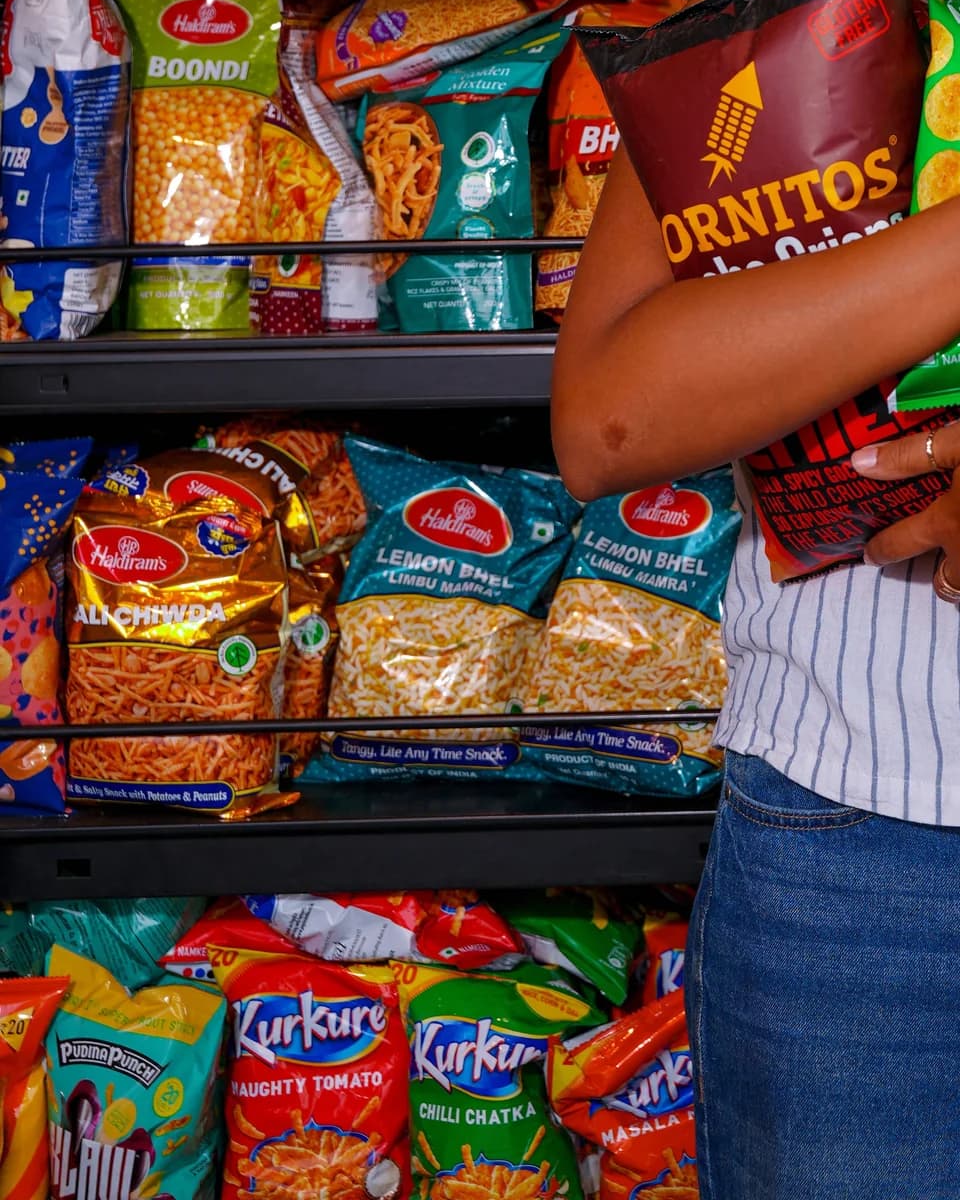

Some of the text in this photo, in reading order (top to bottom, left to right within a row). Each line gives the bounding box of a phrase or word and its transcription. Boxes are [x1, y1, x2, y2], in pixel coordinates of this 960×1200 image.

[173, 11, 237, 34] Haldiram's
[836, 17, 875, 50] FREE
[148, 56, 249, 80] BOONDI
[660, 145, 898, 263] ORNITOS
[784, 467, 825, 494] SPICY
[785, 488, 827, 512] WILD
[858, 499, 887, 516] IT'S
[883, 488, 921, 510] SURE
[922, 479, 941, 494] TO
[634, 498, 690, 526] Haldiram's
[420, 508, 494, 547] Haldiram's
[814, 522, 858, 546] HEAT
[90, 547, 168, 574] Haldiram's
[583, 529, 709, 577] LEMON BHEL
[376, 547, 514, 590] LEMON BHEL
[73, 602, 226, 626] ALI CHIWDA
[575, 731, 596, 747] Any
[597, 733, 625, 749] Time
[404, 747, 429, 762] Any
[432, 748, 462, 760] Time
[465, 747, 507, 763] Snack.
[545, 753, 636, 773] PRODUCT INDIA
[147, 791, 182, 801] Potatoes
[193, 791, 228, 801] Peanuts
[394, 963, 417, 984] 20
[234, 990, 387, 1068] Kurkure
[414, 1017, 541, 1092] Kurkur
[231, 1071, 382, 1097] NAUGHTY TOMATO
[419, 1102, 537, 1125] CHILLI CHATKA
[601, 1114, 681, 1146] MASALA
